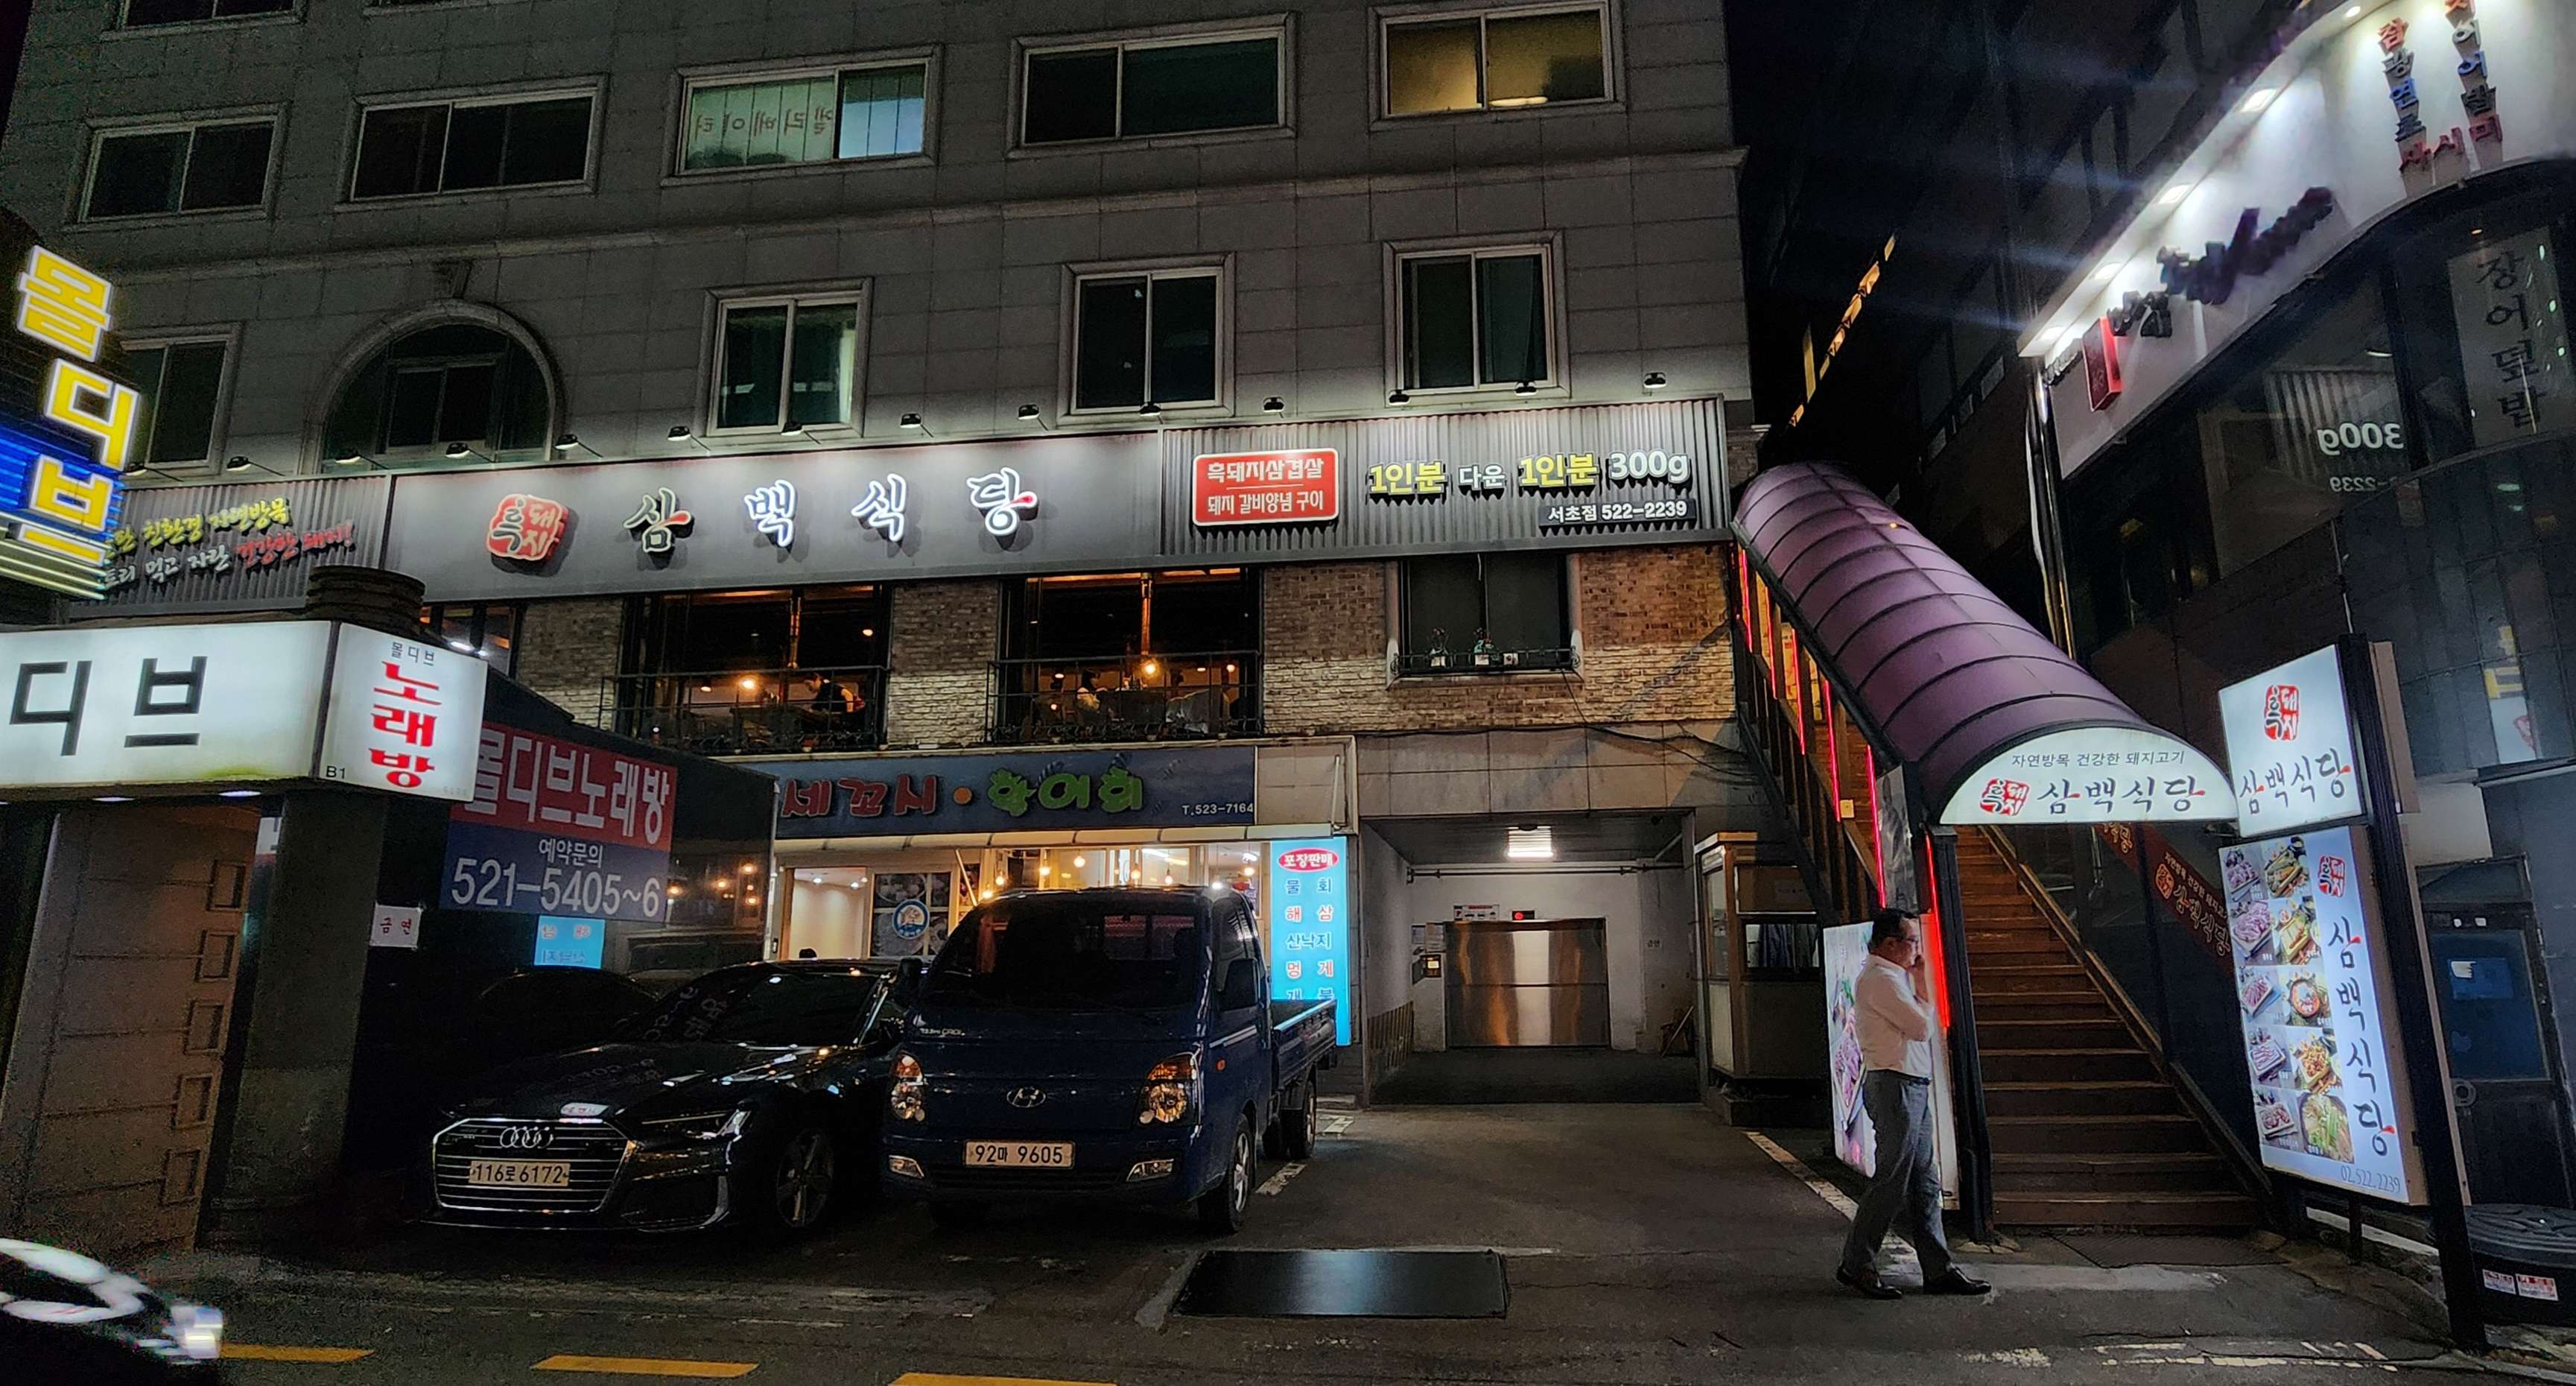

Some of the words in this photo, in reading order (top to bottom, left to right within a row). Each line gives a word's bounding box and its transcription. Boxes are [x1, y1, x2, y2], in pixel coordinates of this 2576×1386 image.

[16, 244, 142, 568] 몰디브
[1208, 458, 1324, 483] 흑돼지삼겹살
[1368, 460, 1447, 496] 1인분
[1458, 464, 1506, 490] 다운
[1518, 452, 1599, 488] 1인분
[1609, 451, 1690, 485] 300g
[624, 467, 1038, 553] 삼백식당
[1208, 495, 1234, 516] 돼지
[1238, 491, 1292, 514] 갈비양념
[1296, 490, 1324, 512] 구이
[1547, 504, 1597, 522] 서초점
[1601, 500, 1688, 519] 522-2239
[145, 557, 179, 583] 먹고
[188, 545, 230, 572] 자란
[236, 531, 296, 568] 건강한
[302, 519, 352, 548] 돼지!
[391, 642, 434, 667] 몰디브
[369, 660, 442, 788] 노래방
[326, 765, 346, 780] B1
[2012, 752, 2069, 768] 자연방목
[2077, 752, 2120, 767] 건강한
[2125, 750, 2185, 765] 돼지고기
[464, 728, 670, 844] 몰디브노래방
[781, 774, 936, 818] 세꼬시
[2036, 776, 2206, 814] 삼백식당
[2239, 747, 2351, 815] 삼백식당
[1182, 803, 1254, 816] T.523-7164
[539, 838, 603, 869] 예약문의
[1284, 853, 1333, 867] 포장판매
[451, 858, 660, 917] 521-5405~6
[1287, 934, 1330, 949] 산낙지
[2328, 916, 2396, 1156] 삼백식당
[975, 1145, 1008, 1162] 92마
[1018, 1145, 1062, 1164] 9605
